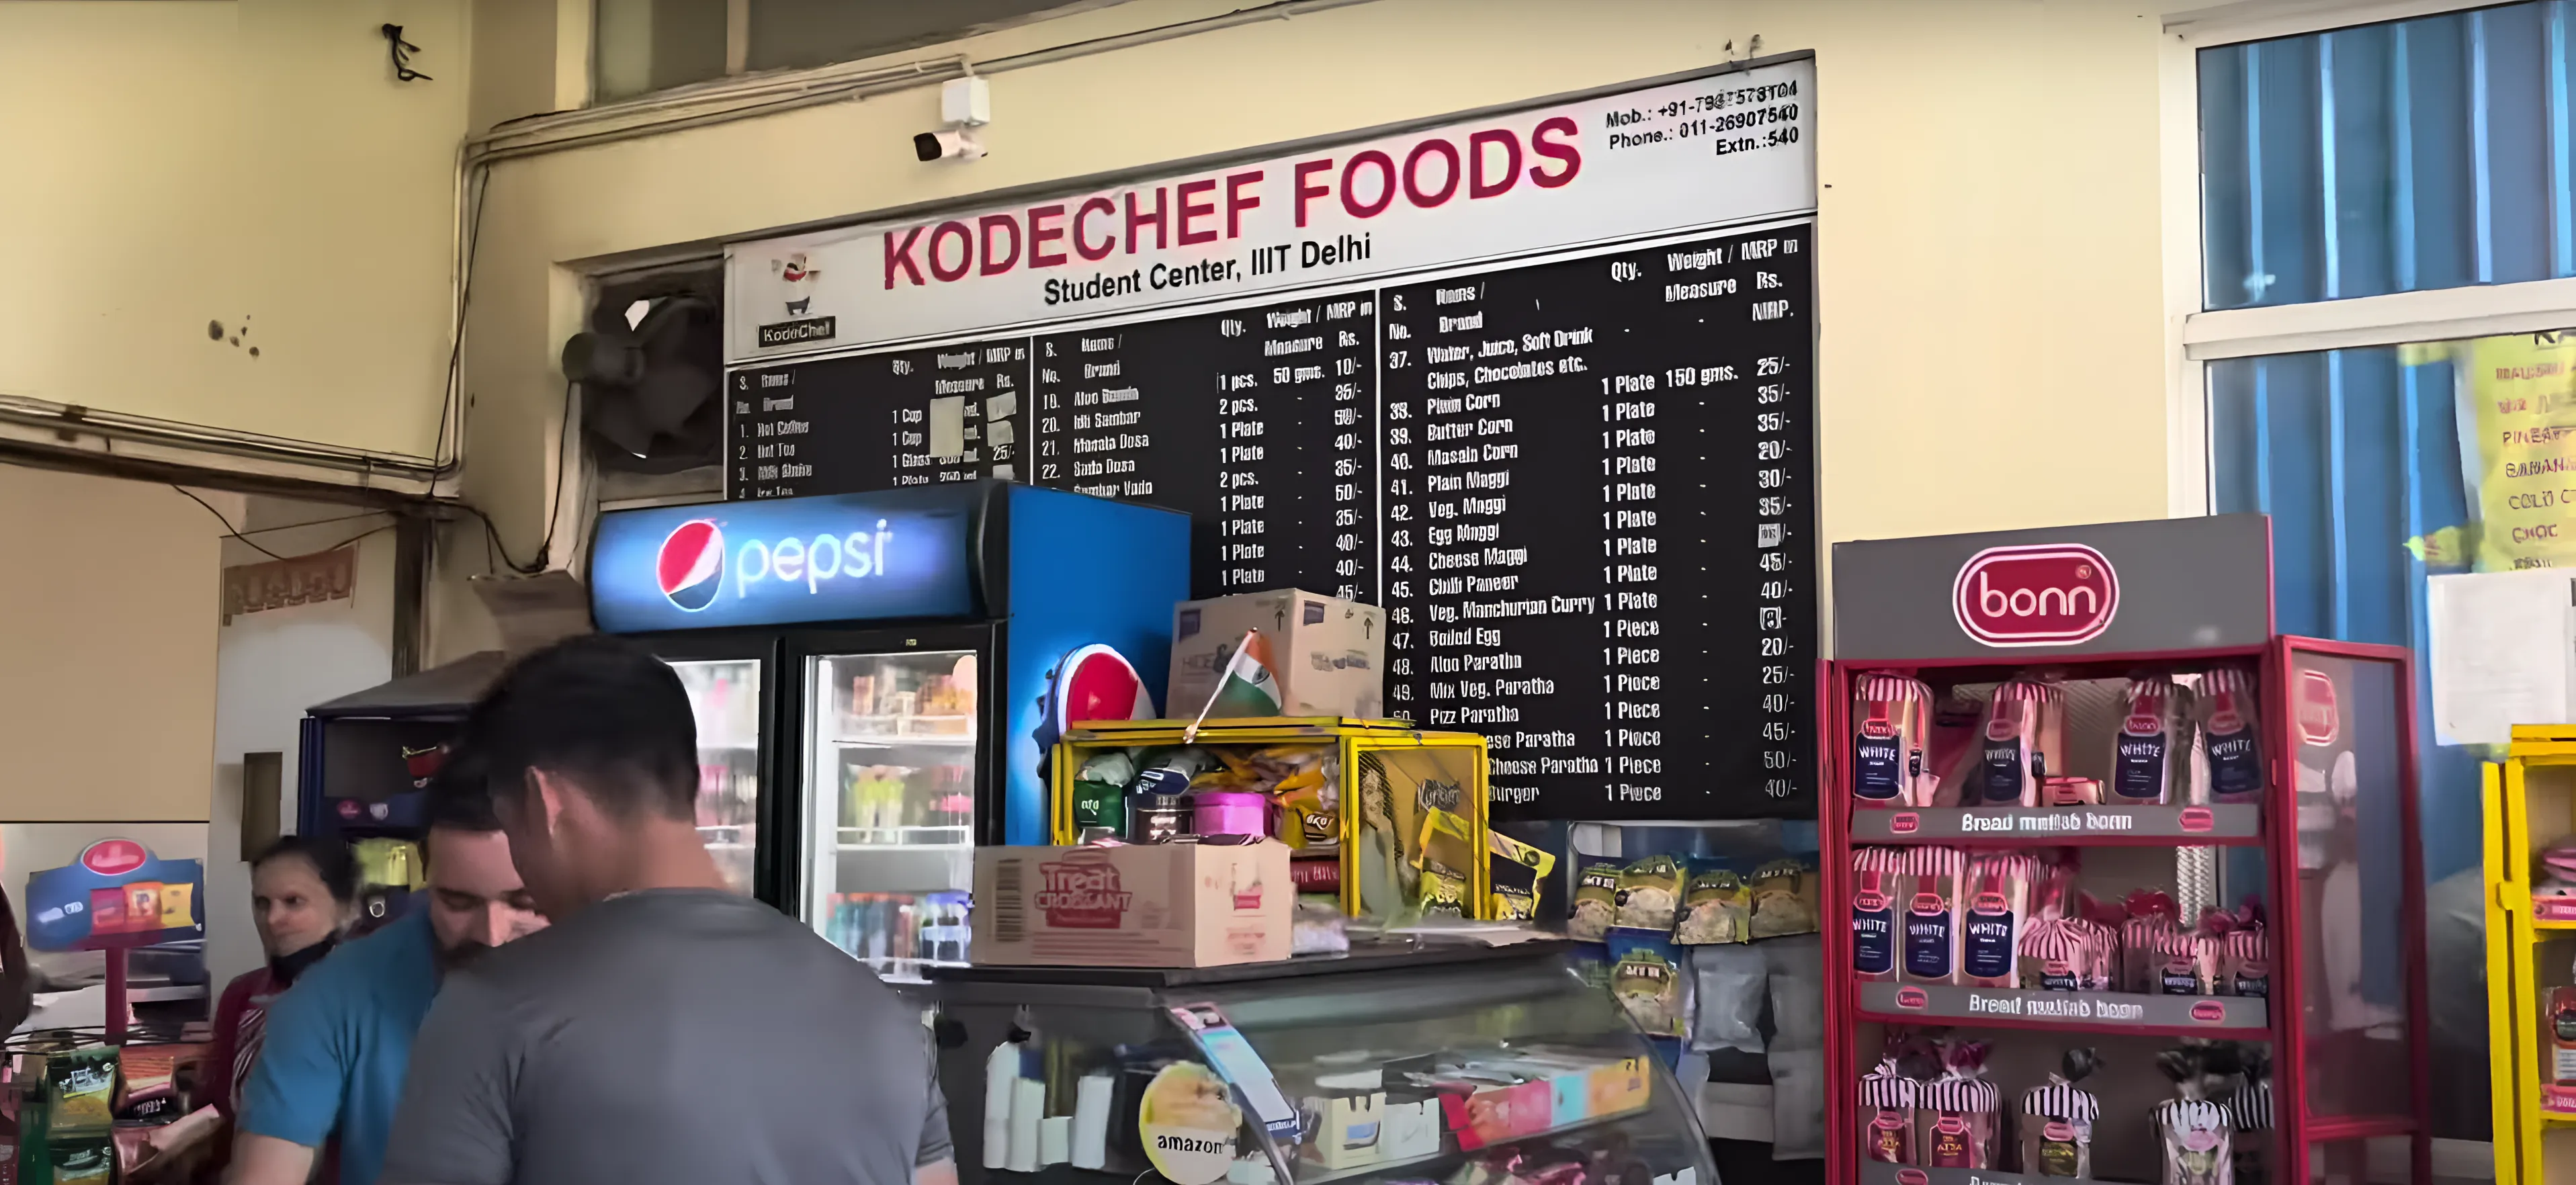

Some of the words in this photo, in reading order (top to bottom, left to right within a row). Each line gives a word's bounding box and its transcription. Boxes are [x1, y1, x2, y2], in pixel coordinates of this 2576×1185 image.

[1606, 108, 1651, 128] Mob.:
[1610, 128, 1673, 150] Phone.:
[883, 169, 1265, 291] KODECHEF
[1293, 116, 1583, 230] FOODS
[1044, 271, 1144, 307] Student
[1150, 258, 1241, 296] Center,
[1252, 244, 1291, 276] IIIT
[1301, 232, 1370, 269] Delhi
[1611, 261, 1642, 283] Qty.
[1741, 238, 1778, 261] MRP
[1665, 278, 1737, 302] Measure
[1389, 351, 1412, 369] 37.
[1522, 331, 1551, 352] Soft
[1553, 326, 1593, 347] Drink
[1465, 393, 1500, 411] Corn
[1615, 374, 1656, 394] Plate
[1666, 367, 1696, 388] 150
[1477, 418, 1513, 436] Corn
[1616, 401, 1656, 421] Plate
[1758, 383, 1791, 404] 35/-
[1232, 421, 1264, 438] Plate
[1390, 452, 1413, 470] 40.
[1483, 443, 1518, 462] Corn
[1616, 428, 1656, 448] Plate
[1757, 410, 1791, 432] 35/-
[1232, 445, 1264, 463] Plate
[1390, 479, 1413, 496] 41.
[1428, 473, 1462, 493] Plain
[1466, 469, 1510, 490] Maggi
[1617, 455, 1656, 475] Plate
[1758, 439, 1793, 460] 20/-
[1390, 504, 1413, 522] 42.
[1617, 482, 1656, 502] Plate
[1758, 467, 1792, 488] 30/-
[1391, 529, 1413, 547] 43.
[1428, 526, 1453, 546] Egg
[1617, 510, 1657, 529] Plate
[736, 518, 892, 599] pepsi
[1391, 555, 1413, 573] 44.
[1428, 552, 1479, 570] Cheese
[1617, 537, 1657, 556] Plate
[1391, 580, 1414, 598] 45.
[1466, 575, 1519, 592] Paneer
[1617, 564, 1658, 582] Plate
[1980, 570, 2097, 618] bonn
[1429, 604, 1459, 623] Veg.
[1463, 598, 1547, 619] Manchurian
[1551, 595, 1595, 615] Curry
[1618, 591, 1658, 611] Plate
[1760, 579, 1793, 599] 40/-
[1392, 632, 1414, 650] 47.
[1476, 627, 1501, 647] Egg
[1617, 619, 1660, 638] Piece
[1392, 658, 1414, 675] 48.
[1430, 655, 1459, 673] Aloo
[1463, 652, 1522, 672] Paratha
[1617, 646, 1660, 665] Piece
[1762, 637, 1794, 656] 20/-
[1430, 682, 1455, 699] Mix
[1460, 680, 1491, 699] Veg.
[1496, 676, 1554, 697] Paratha
[1762, 666, 1795, 685] 25/-
[1430, 708, 1457, 725] Pizz
[1461, 705, 1519, 723] Paratha
[1618, 701, 1660, 719] Piece
[1762, 694, 1795, 713] 40/-
[1516, 730, 1575, 748] Paratha
[1762, 722, 1795, 741] 45/-
[2119, 742, 2161, 758] WHITE
[1541, 756, 1598, 775] Paratha
[1619, 756, 1662, 775] Piece
[1764, 750, 1797, 769] 50/-
[1858, 744, 1897, 762] WHITE
[1765, 779, 1797, 797] 40/-
[1041, 864, 1117, 892] Treat
[1852, 918, 1887, 934] WHITE
[1156, 1134, 1223, 1155] amazon
